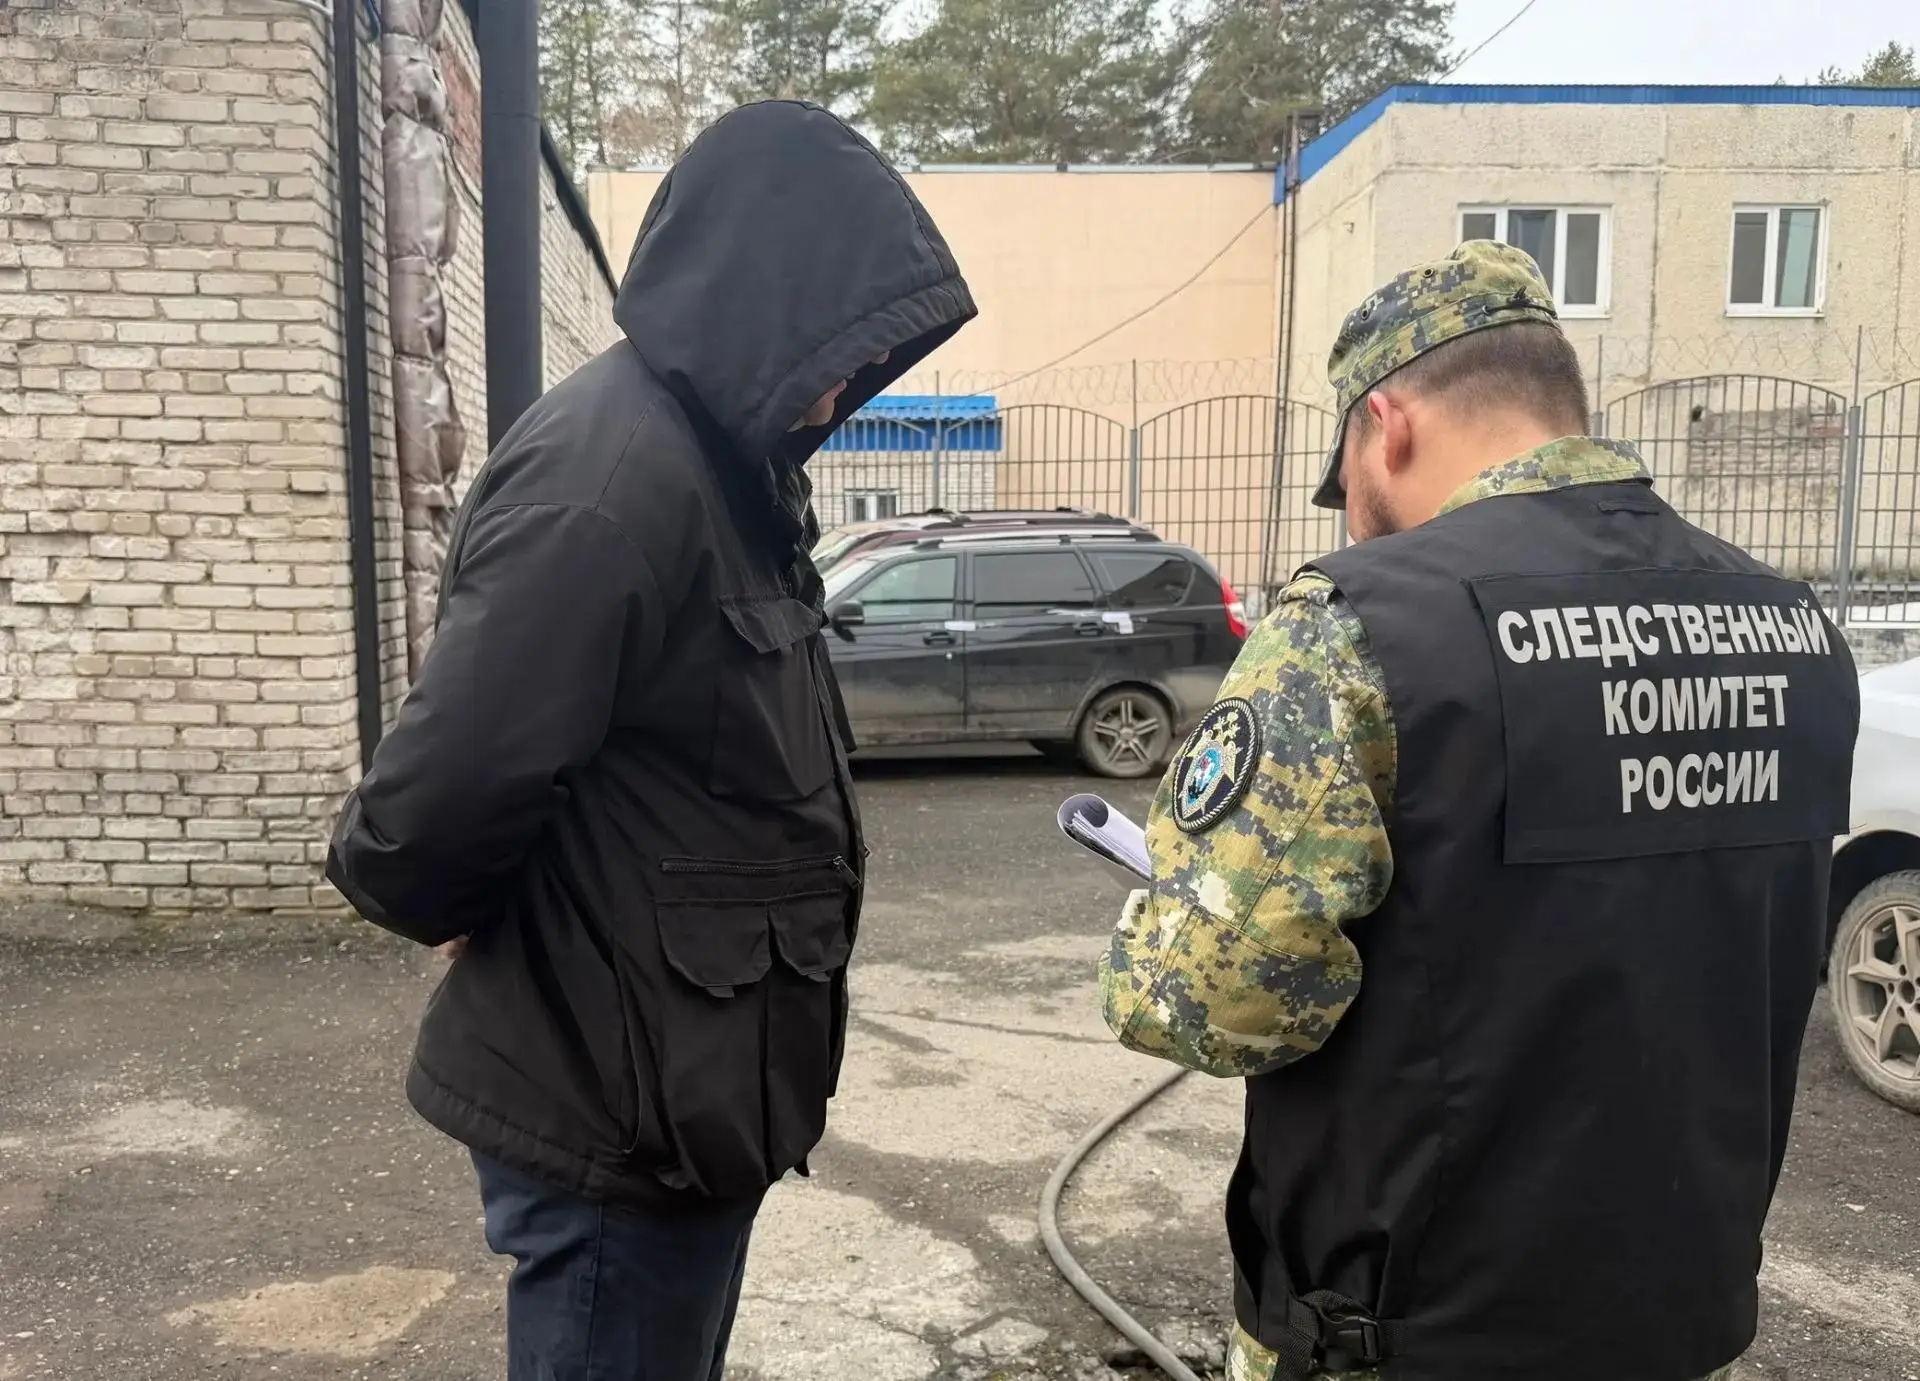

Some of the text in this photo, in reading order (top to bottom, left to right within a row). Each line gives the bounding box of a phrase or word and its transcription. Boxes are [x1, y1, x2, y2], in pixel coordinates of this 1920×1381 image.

[1498, 598, 1831, 669] СЛЕДСТВЕННЫЙ
[1601, 675, 1789, 736] КОМИТЕТ
[1620, 749, 1780, 814] РОССИИ
